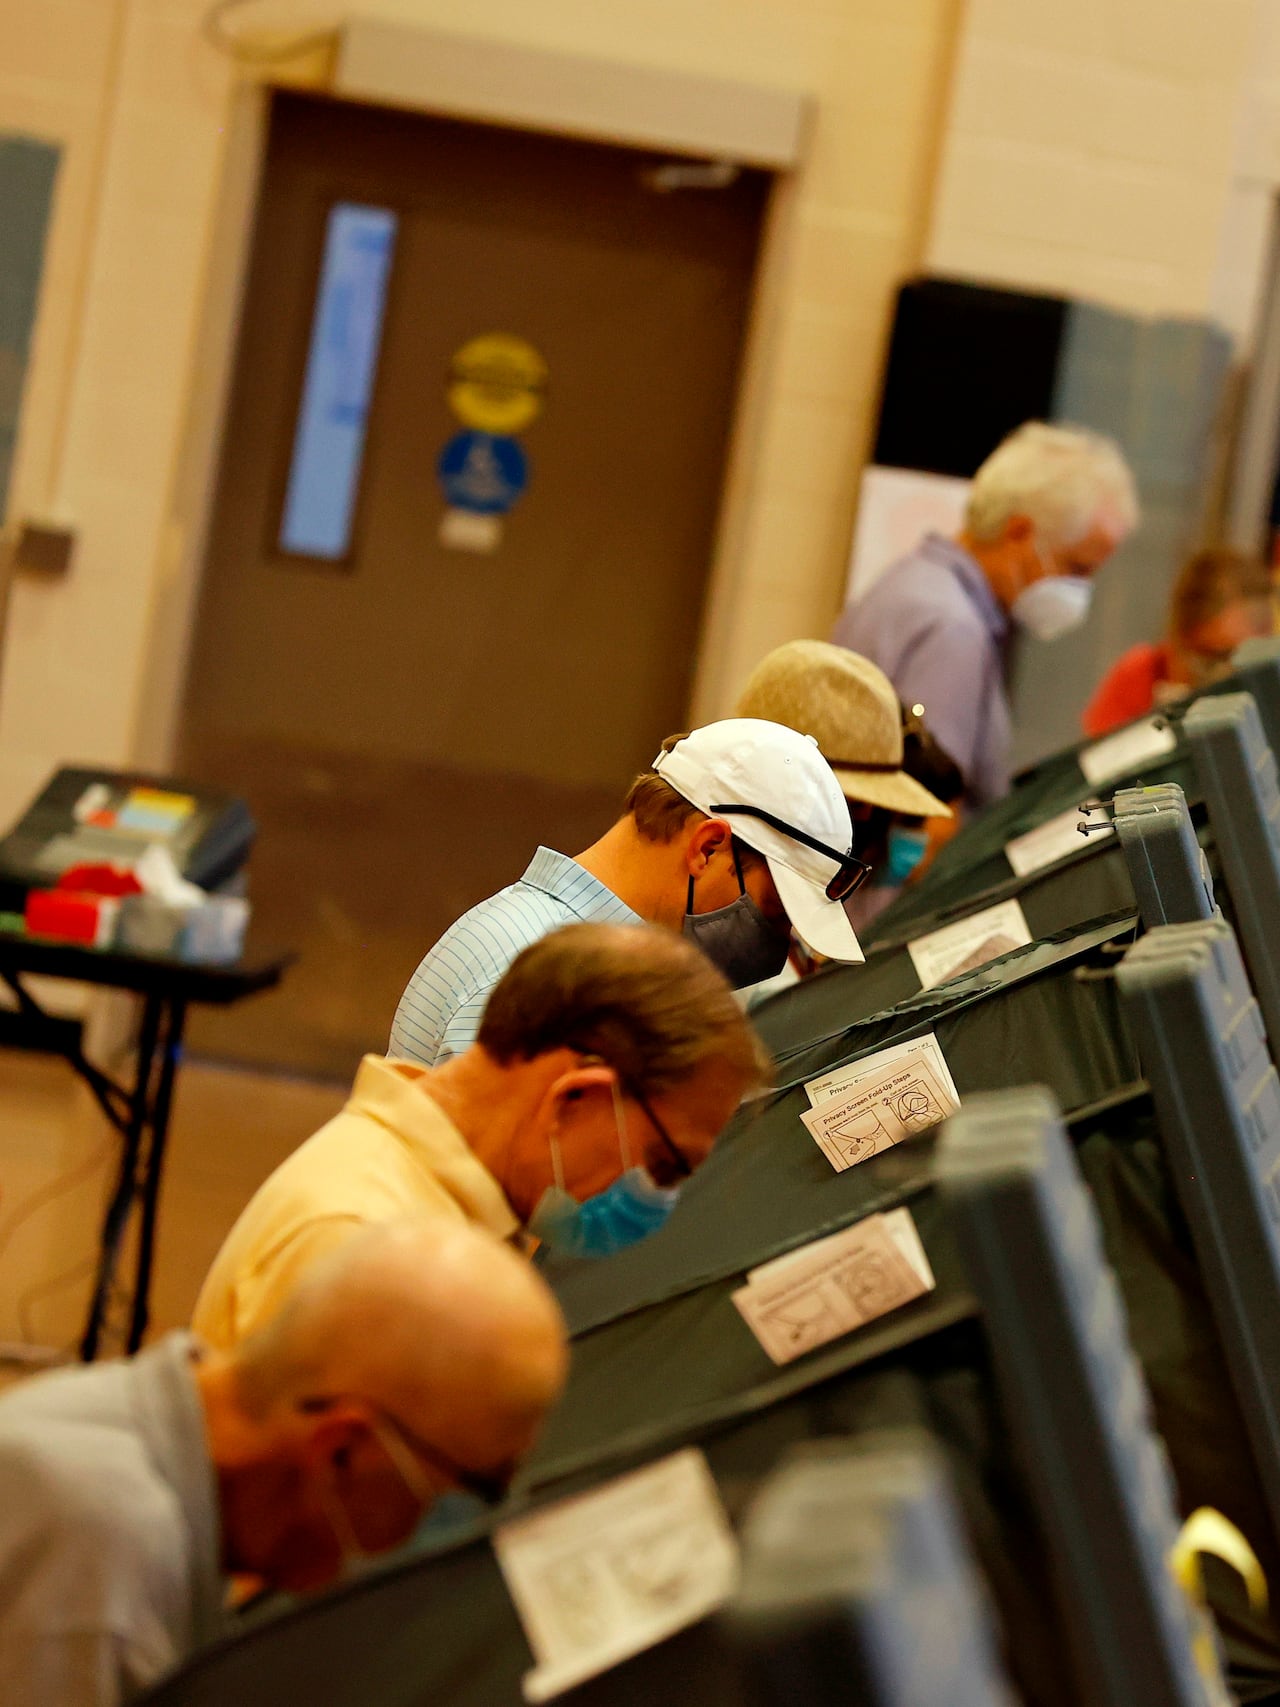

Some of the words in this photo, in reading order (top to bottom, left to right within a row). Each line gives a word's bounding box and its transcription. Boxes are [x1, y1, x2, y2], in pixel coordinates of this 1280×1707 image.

[823, 1110, 846, 1125] Privacy
[846, 1097, 869, 1111] Screen
[868, 1083, 893, 1100] Fold-Up
[892, 1073, 911, 1086] Steps
